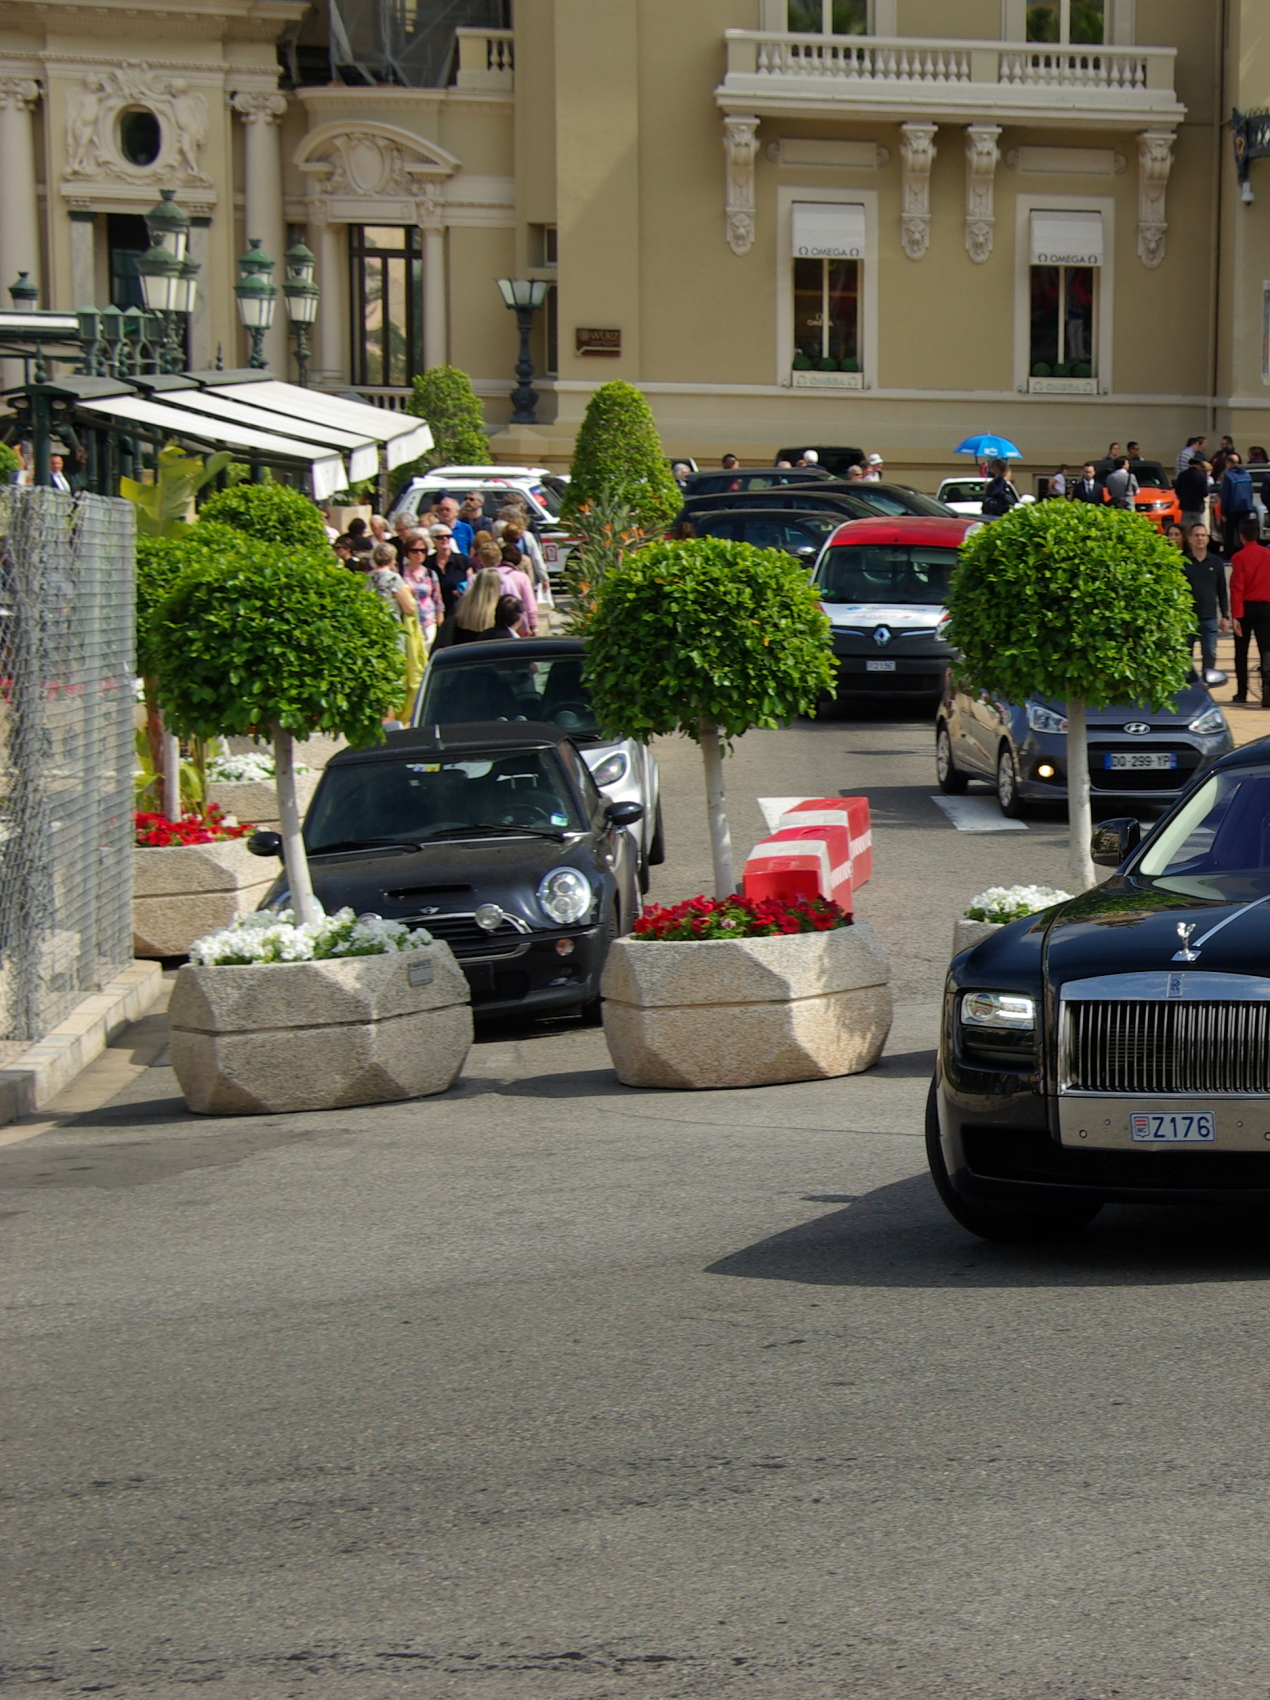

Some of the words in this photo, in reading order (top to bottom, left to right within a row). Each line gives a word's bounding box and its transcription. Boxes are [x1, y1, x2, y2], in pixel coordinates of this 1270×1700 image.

[811, 247, 848, 257] OMEGA
[1050, 254, 1086, 264] OMEGA
[1152, 1116, 1211, 1138] Z176
